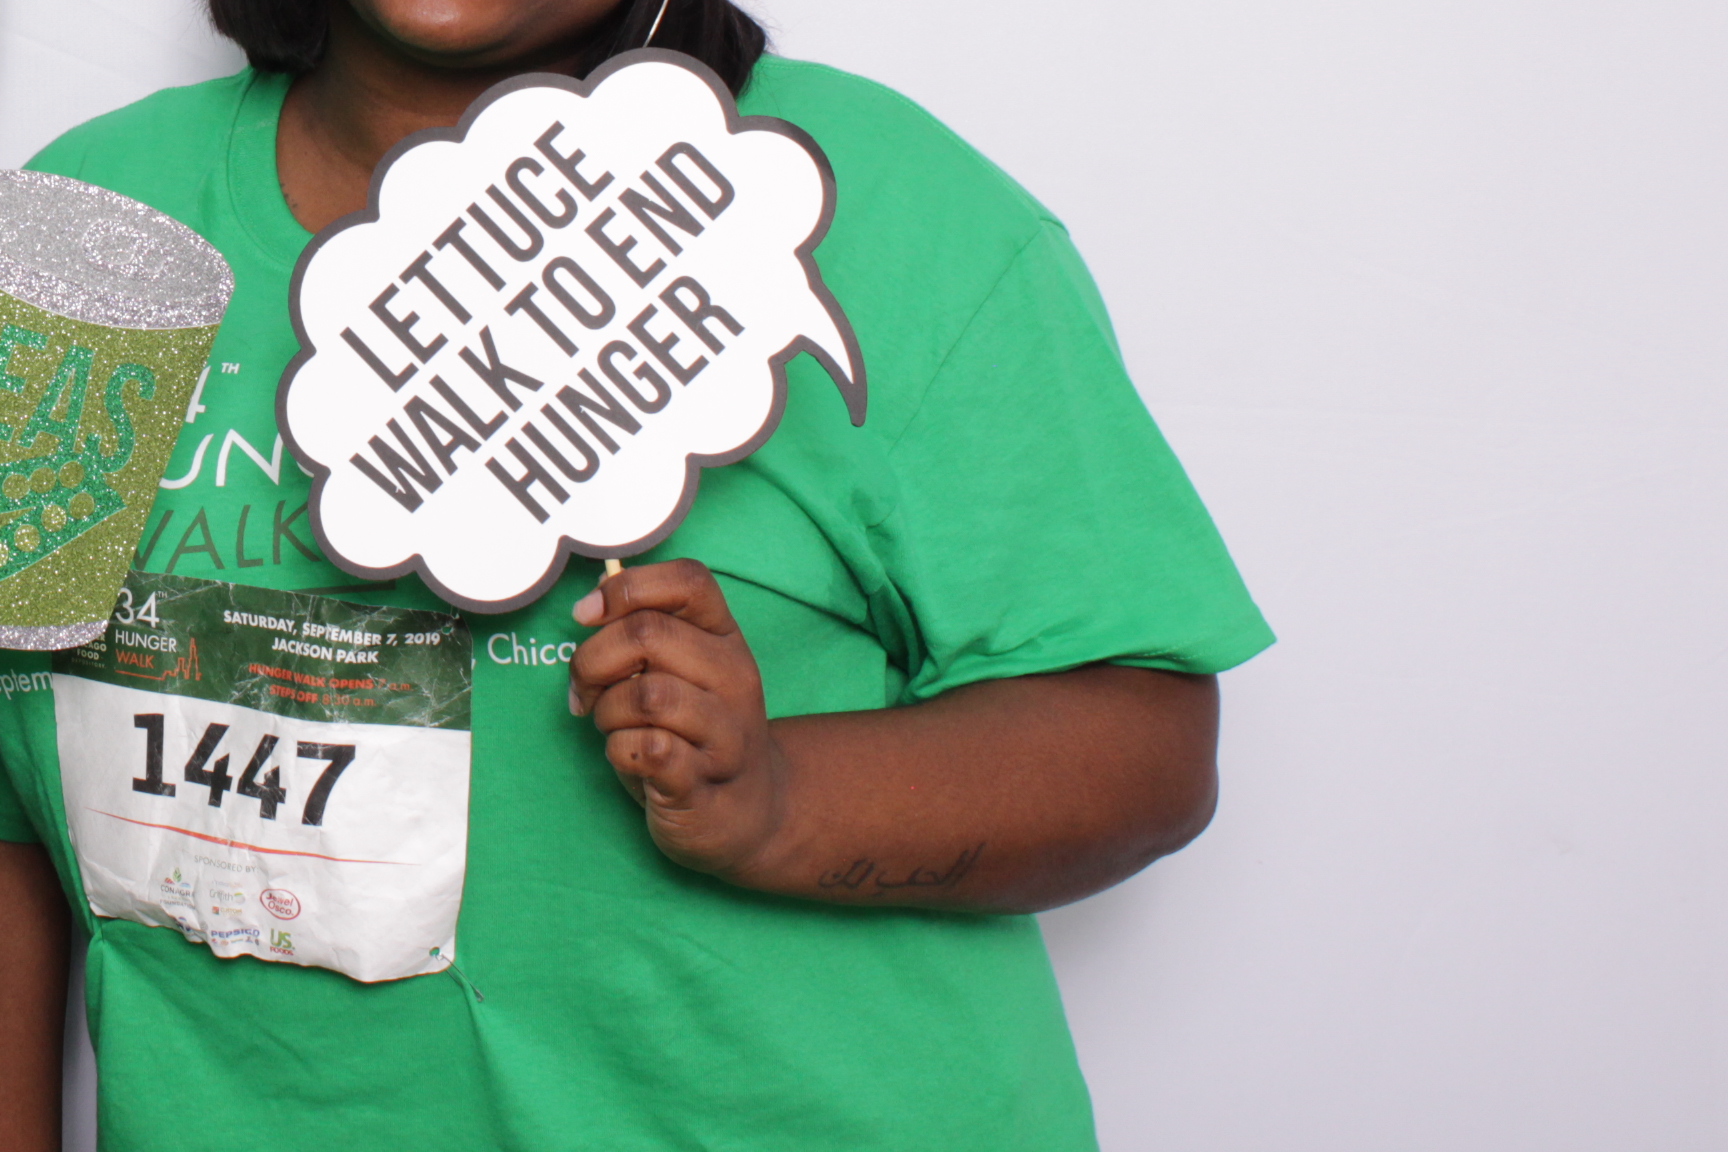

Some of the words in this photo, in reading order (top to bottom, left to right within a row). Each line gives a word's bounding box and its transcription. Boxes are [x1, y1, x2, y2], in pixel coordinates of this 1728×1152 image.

[340, 119, 616, 393] LETTUCE
[349, 325, 545, 514] WALK
[503, 255, 616, 358] TO
[583, 141, 736, 290] END
[484, 274, 746, 524] HUNGER
[223, 609, 297, 636] SATURDAY,
[302, 622, 382, 647] SEPTEMBER
[386, 633, 399, 647] 7,
[404, 632, 441, 646] 2019
[115, 629, 178, 653] HUNGER
[272, 637, 333, 661] JACKSON
[336, 649, 379, 664] PARK
[77, 648, 100, 661] FOOD
[116, 649, 155, 669] WALK
[249, 663, 293, 681] HUNGER
[293, 671, 326, 688] WALK
[329, 677, 375, 690] OPENS
[388, 681, 414, 693] a.m.
[269, 684, 296, 700] STEPS
[296, 691, 319, 705] OFF
[352, 697, 377, 708] a.m.
[132, 713, 356, 827] 1447
[193, 854, 243, 873] SPONSORED
[266, 892, 294, 906] Jewel
[210, 927, 260, 939] PEPSICO
